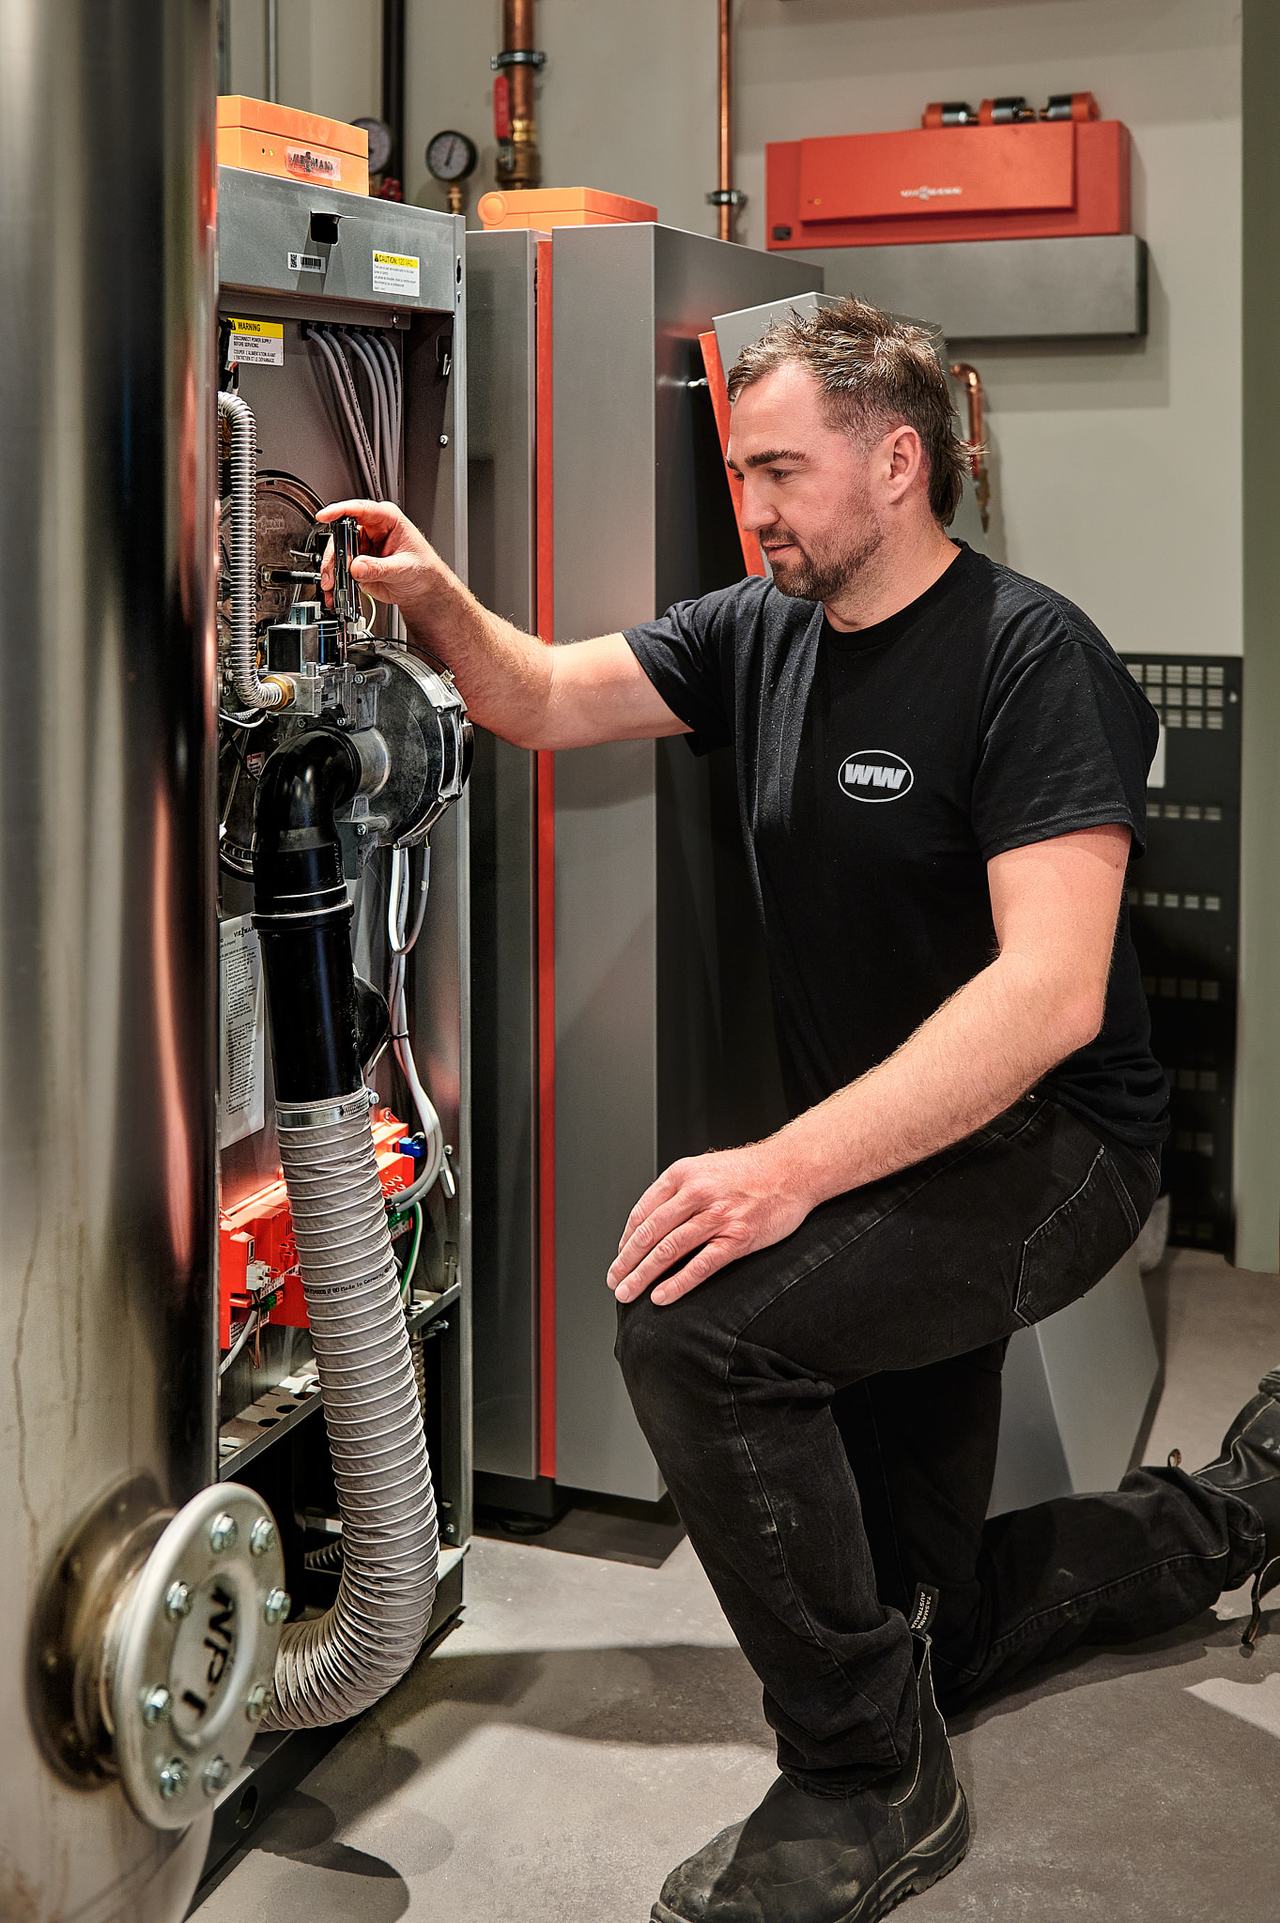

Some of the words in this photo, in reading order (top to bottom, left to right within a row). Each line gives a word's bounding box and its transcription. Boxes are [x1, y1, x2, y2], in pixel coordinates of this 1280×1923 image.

[238, 322, 260, 332] WARNING
[845, 763, 908, 790] WW
[911, 1591, 925, 1628] AUSTRALIA
[916, 1595, 931, 1628] TASMANIA
